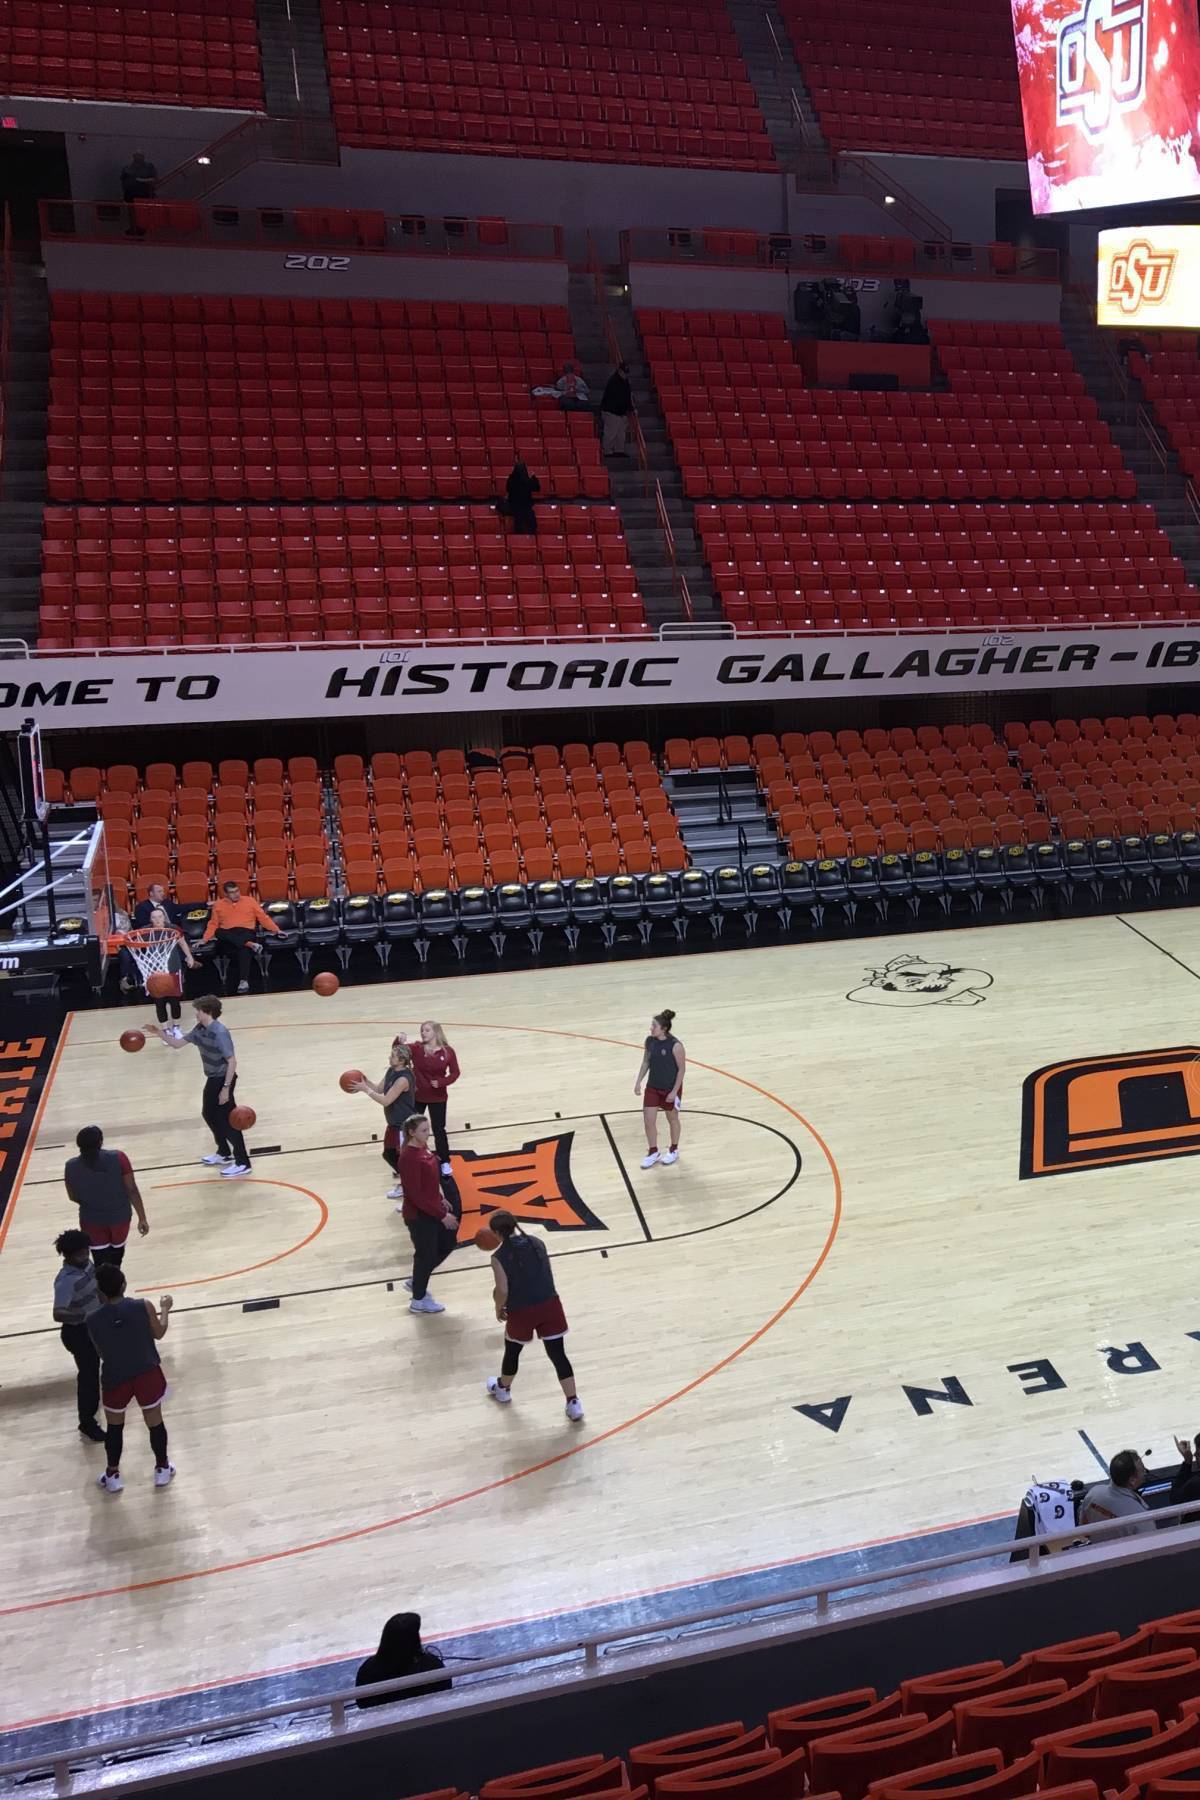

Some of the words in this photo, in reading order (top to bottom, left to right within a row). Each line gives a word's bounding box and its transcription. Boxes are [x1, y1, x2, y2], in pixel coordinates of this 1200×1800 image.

[284, 254, 351, 271] 202
[1108, 239, 1179, 315] OSU
[982, 634, 1016, 647] 102
[379, 650, 411, 664] 101
[136, 674, 220, 702] TO
[325, 657, 680, 698] HISTORIC
